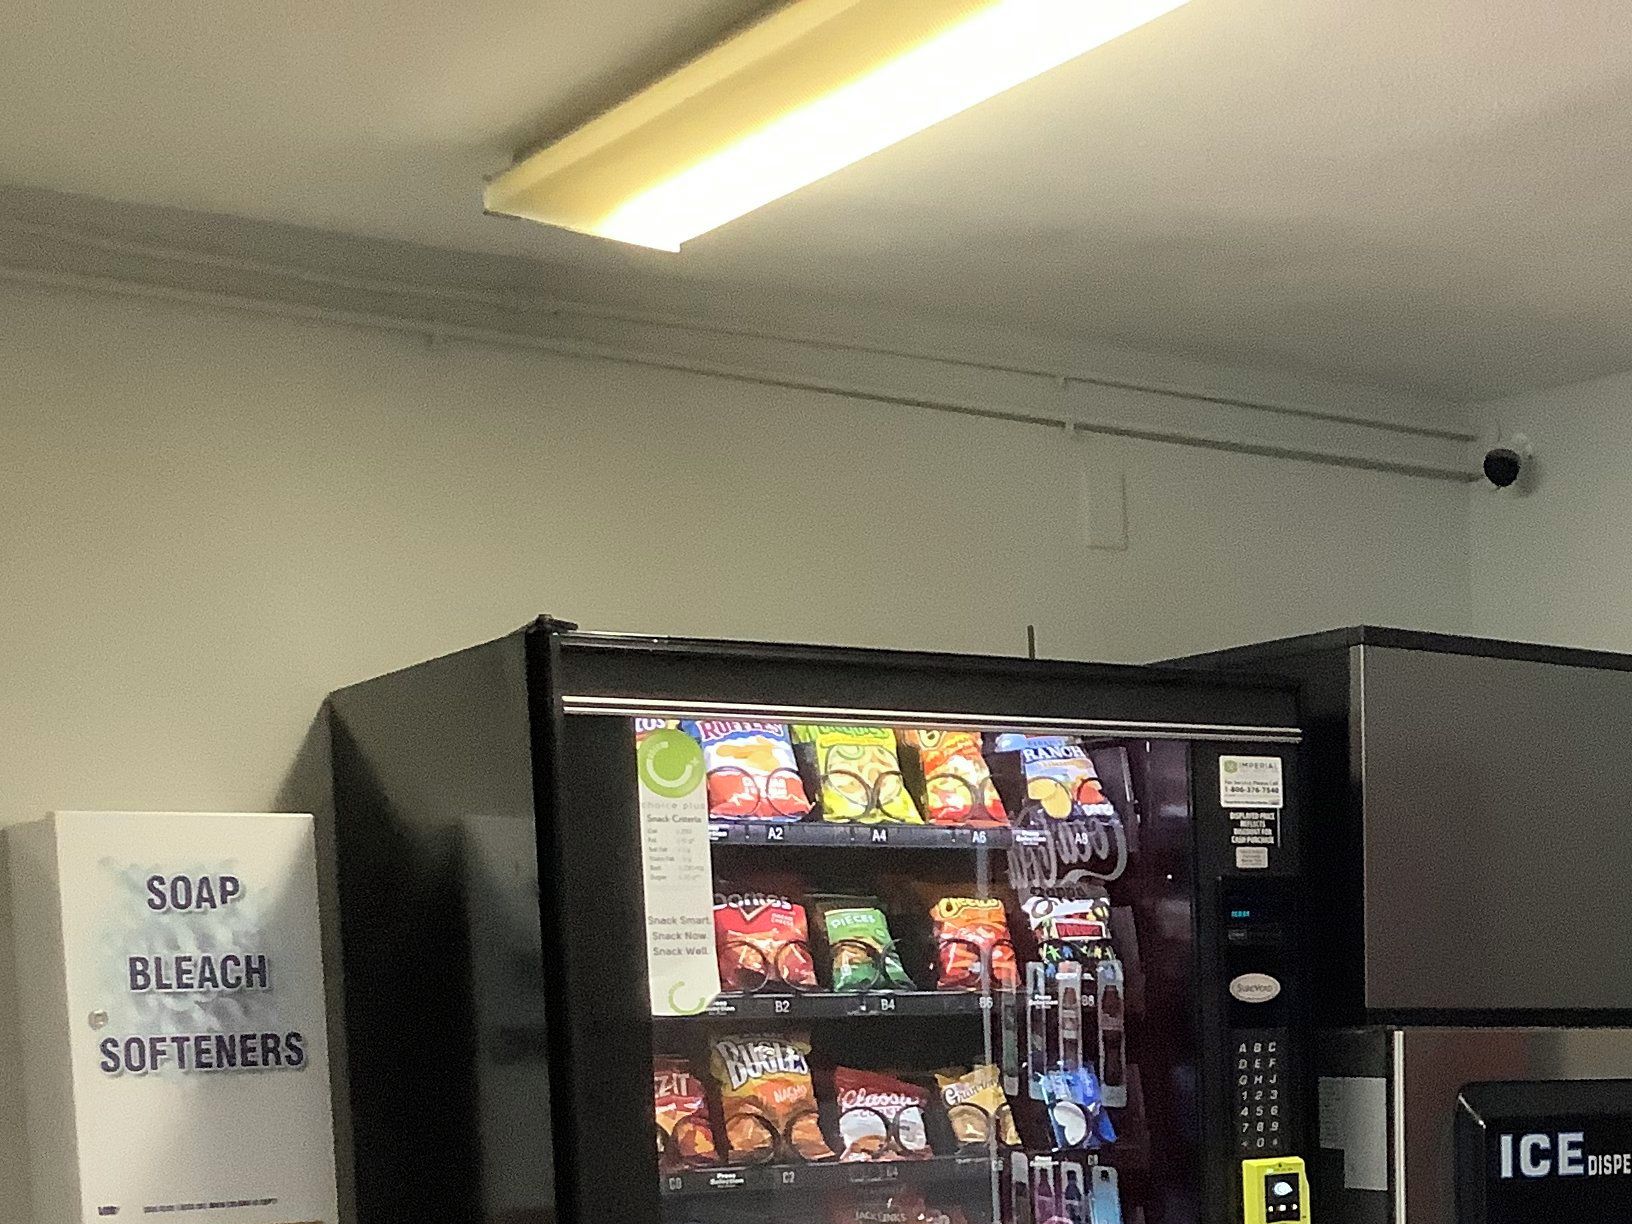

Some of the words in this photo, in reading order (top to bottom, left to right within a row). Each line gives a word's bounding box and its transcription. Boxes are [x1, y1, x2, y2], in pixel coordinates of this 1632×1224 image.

[1023, 745, 1086, 761] RANCH
[647, 815, 670, 823] Snack
[768, 827, 783, 840] A2
[872, 830, 886, 842] A4
[972, 831, 986, 844] A6
[146, 875, 241, 911] SOAP
[648, 916, 676, 925] Snack
[831, 915, 875, 928] PIECES
[652, 931, 681, 940] Snack
[653, 947, 682, 956] Snack
[128, 954, 268, 991] BLEACH
[775, 1000, 790, 1013] B2
[881, 999, 895, 1011] B4
[99, 1032, 304, 1073] SOFTENERS
[1239, 1043, 1247, 1052] A
[1268, 1042, 1276, 1052] C
[1254, 1059, 1261, 1068] E
[1269, 1058, 1276, 1067] F
[1269, 1074, 1277, 1084] J
[1242, 1091, 1247, 1100] 1
[1254, 1091, 1262, 1100] 2
[1270, 1090, 1278, 1099] 3
[1240, 1106, 1248, 1116] 4
[1256, 1106, 1264, 1116] 5
[1270, 1105, 1278, 1115] 6
[1242, 1123, 1249, 1133] 7
[1270, 1121, 1279, 1131] 9
[1500, 1131, 1585, 1179] ICE
